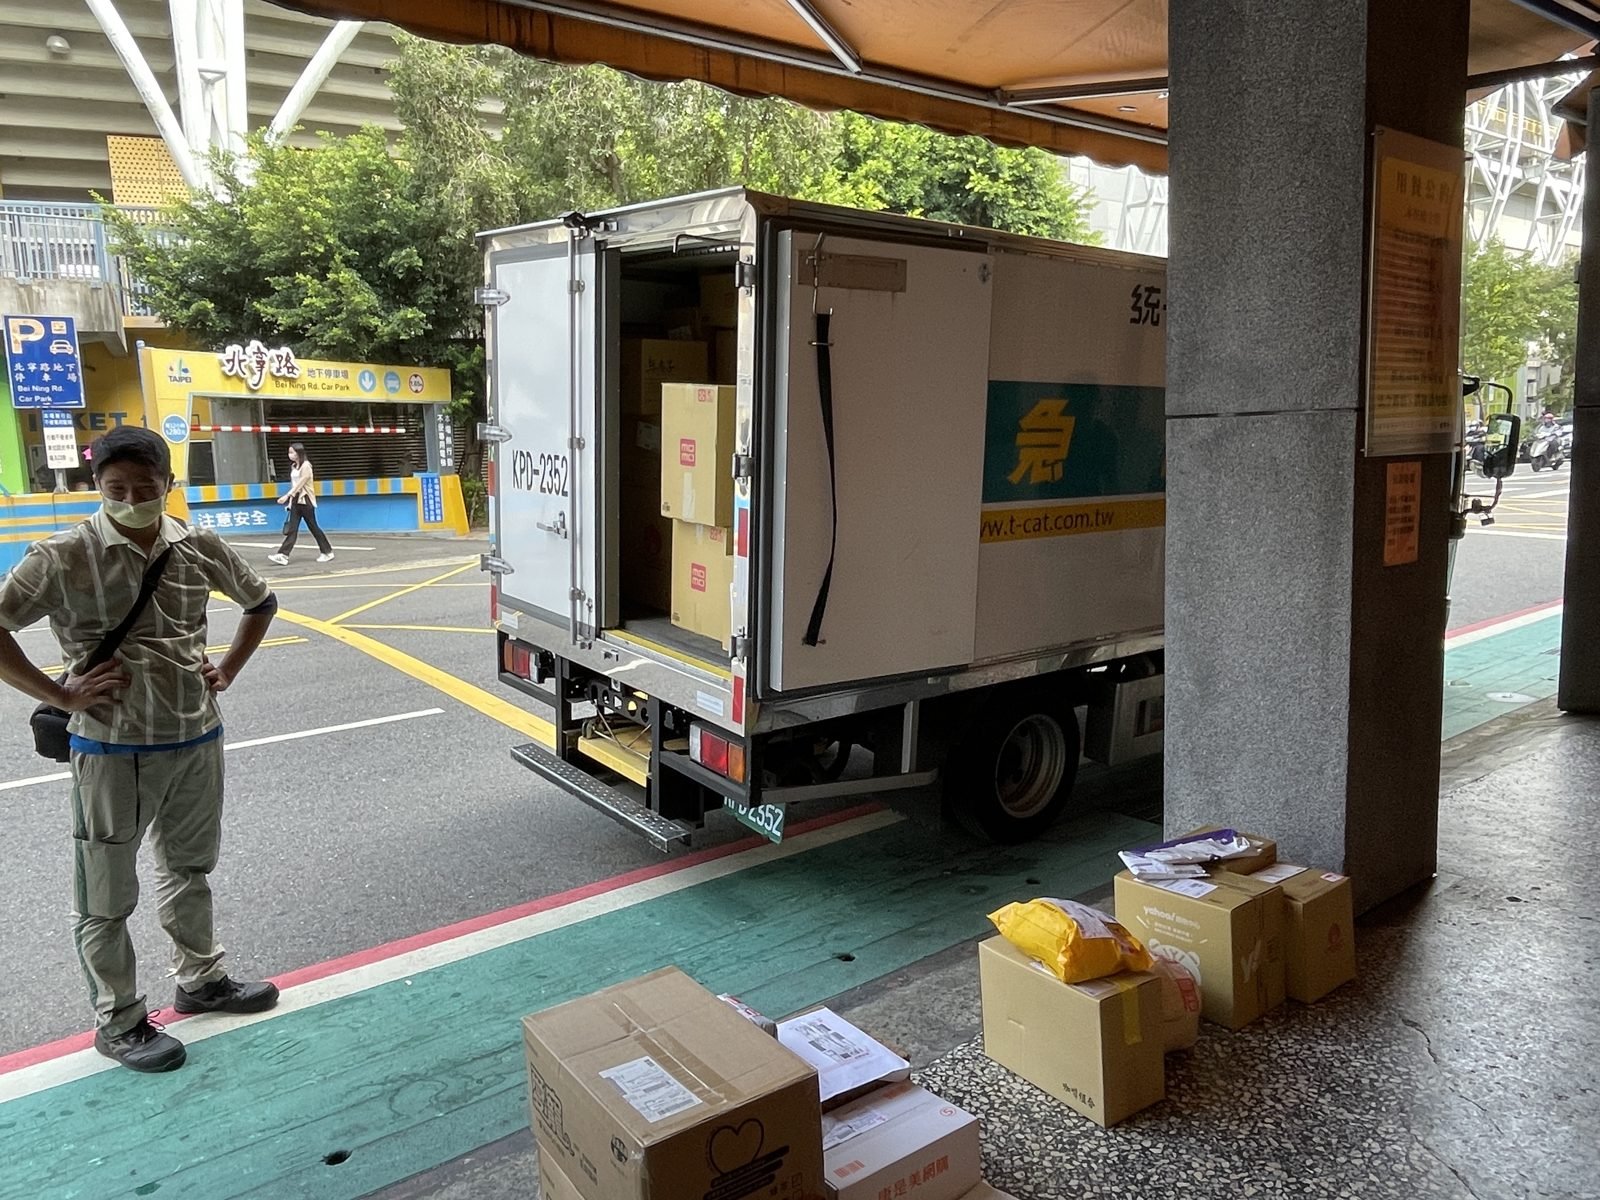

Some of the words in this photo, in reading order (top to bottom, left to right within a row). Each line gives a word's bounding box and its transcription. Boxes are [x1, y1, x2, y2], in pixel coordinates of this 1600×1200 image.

[1130, 284, 1166, 326] 統
[8, 317, 45, 354] P
[168, 375, 192, 384] TAIPEI
[275, 380, 287, 388] Bei
[289, 381, 306, 391] Ning
[321, 383, 333, 391] Car
[32, 385, 50, 393] Ning
[512, 448, 568, 497] KPD-2352
[198, 510, 268, 528] 注意安全
